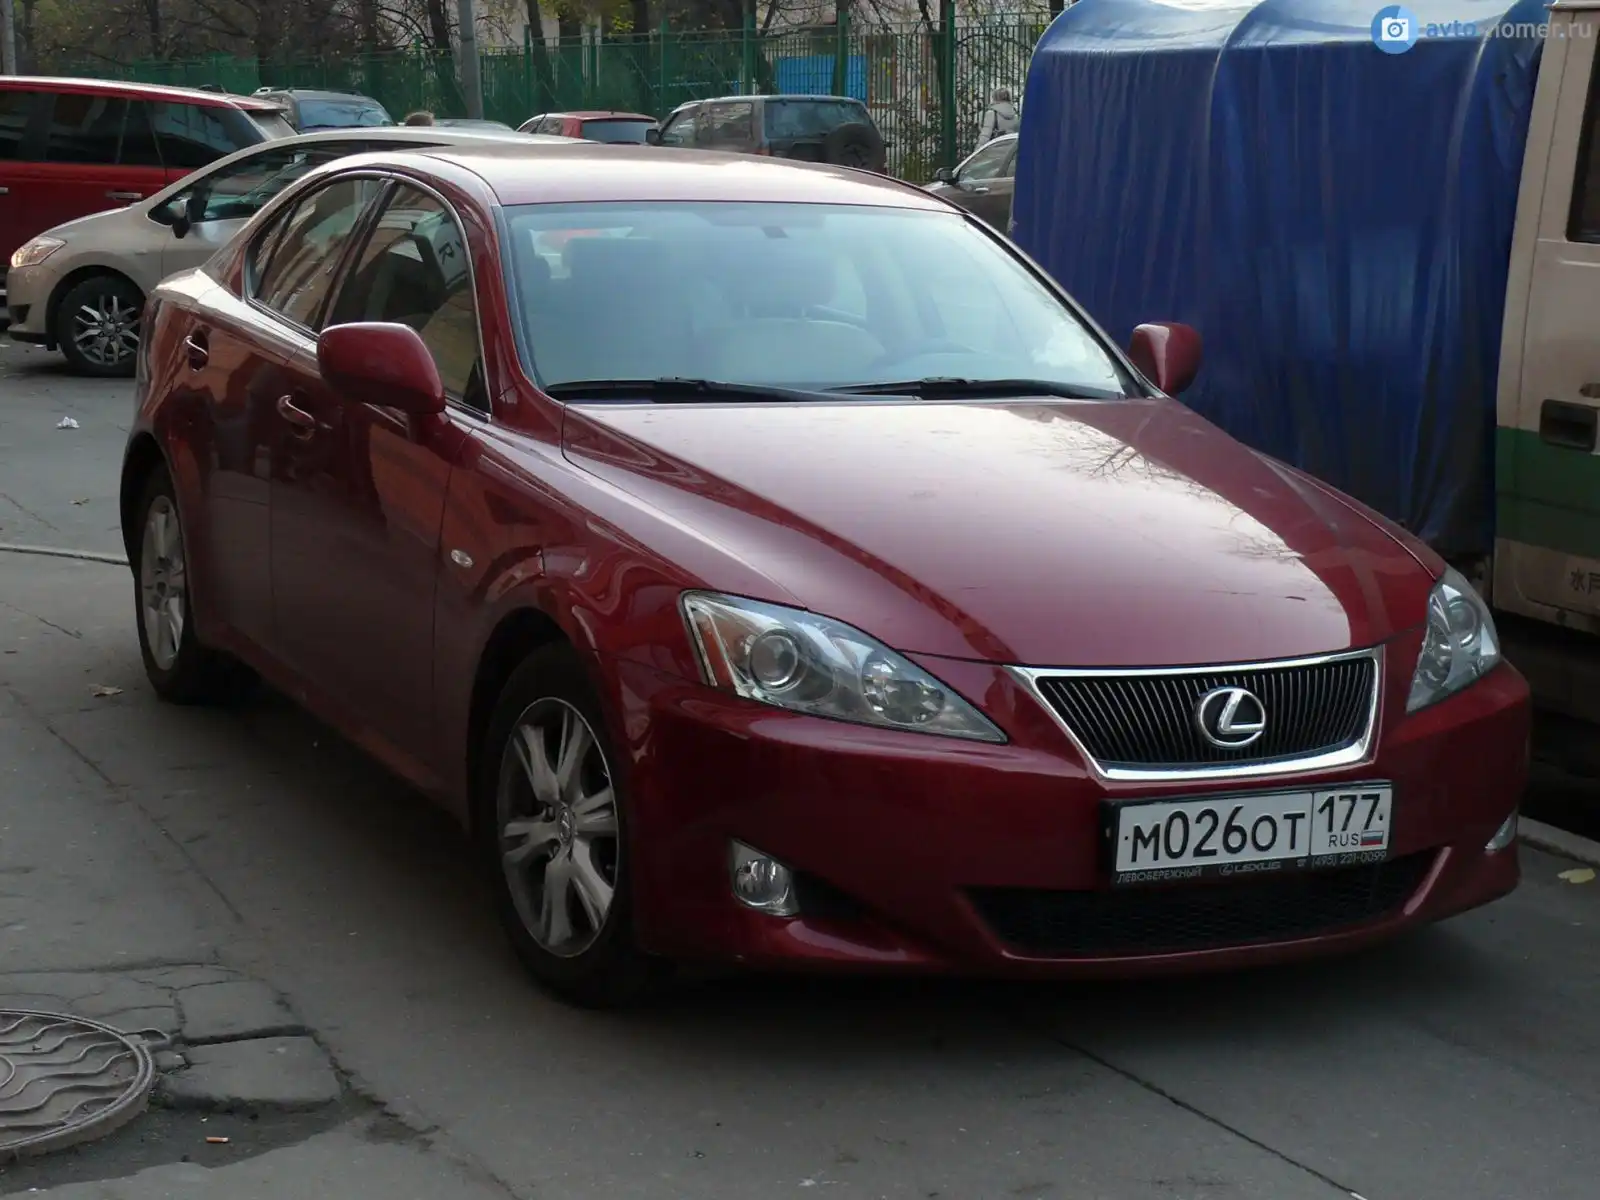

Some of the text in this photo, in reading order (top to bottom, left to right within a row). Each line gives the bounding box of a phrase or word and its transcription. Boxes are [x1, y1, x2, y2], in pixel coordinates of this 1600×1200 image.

[1318, 793, 1381, 833] 177
[1328, 833, 1359, 847] RUS
[1235, 861, 1282, 873] LEXUS
